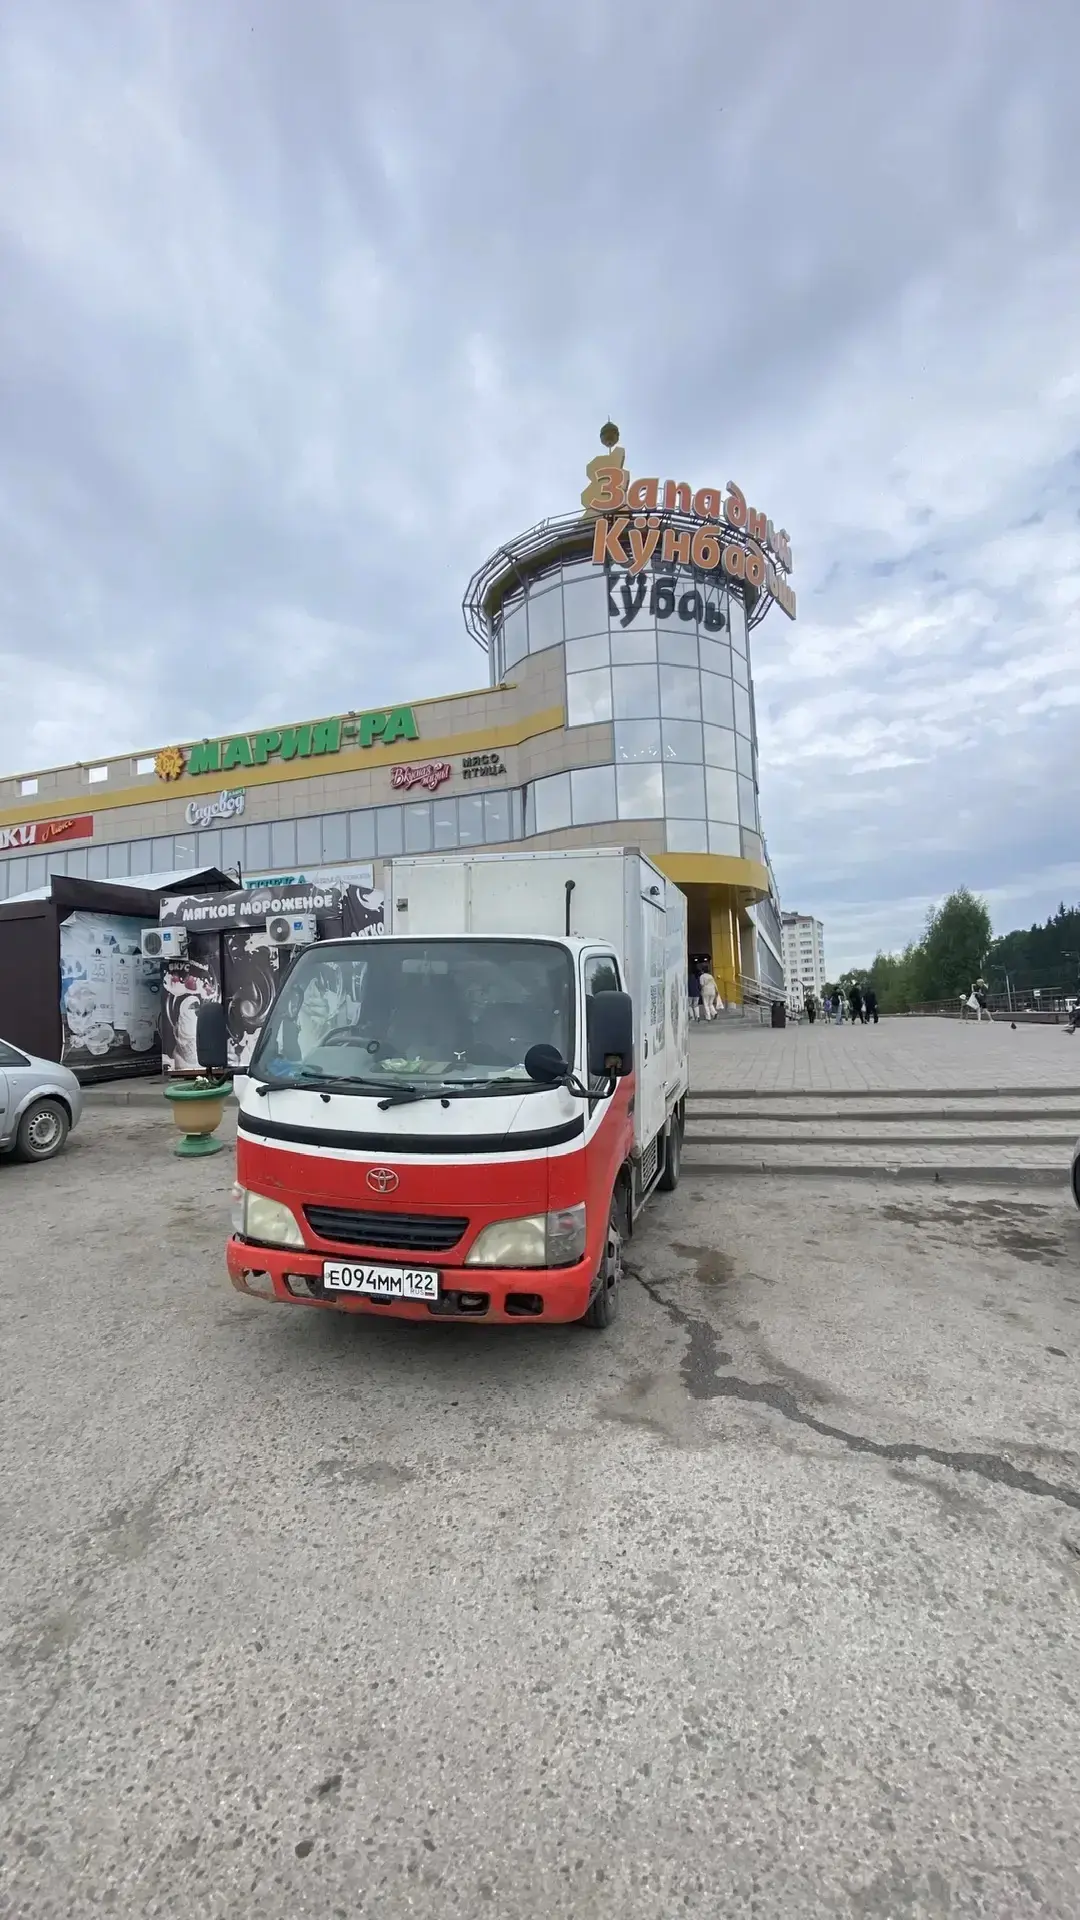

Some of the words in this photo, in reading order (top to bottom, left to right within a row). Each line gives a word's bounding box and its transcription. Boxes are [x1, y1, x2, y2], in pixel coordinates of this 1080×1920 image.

[188, 706, 420, 776] МАРИЯ-РА
[462, 753, 500, 768] МЯСО
[462, 763, 507, 780] ПТИЦА
[185, 789, 245, 827] Садовод
[182, 903, 236, 921] МЯГКОЕ
[240, 894, 333, 915] МОРОЖЕНОЕ
